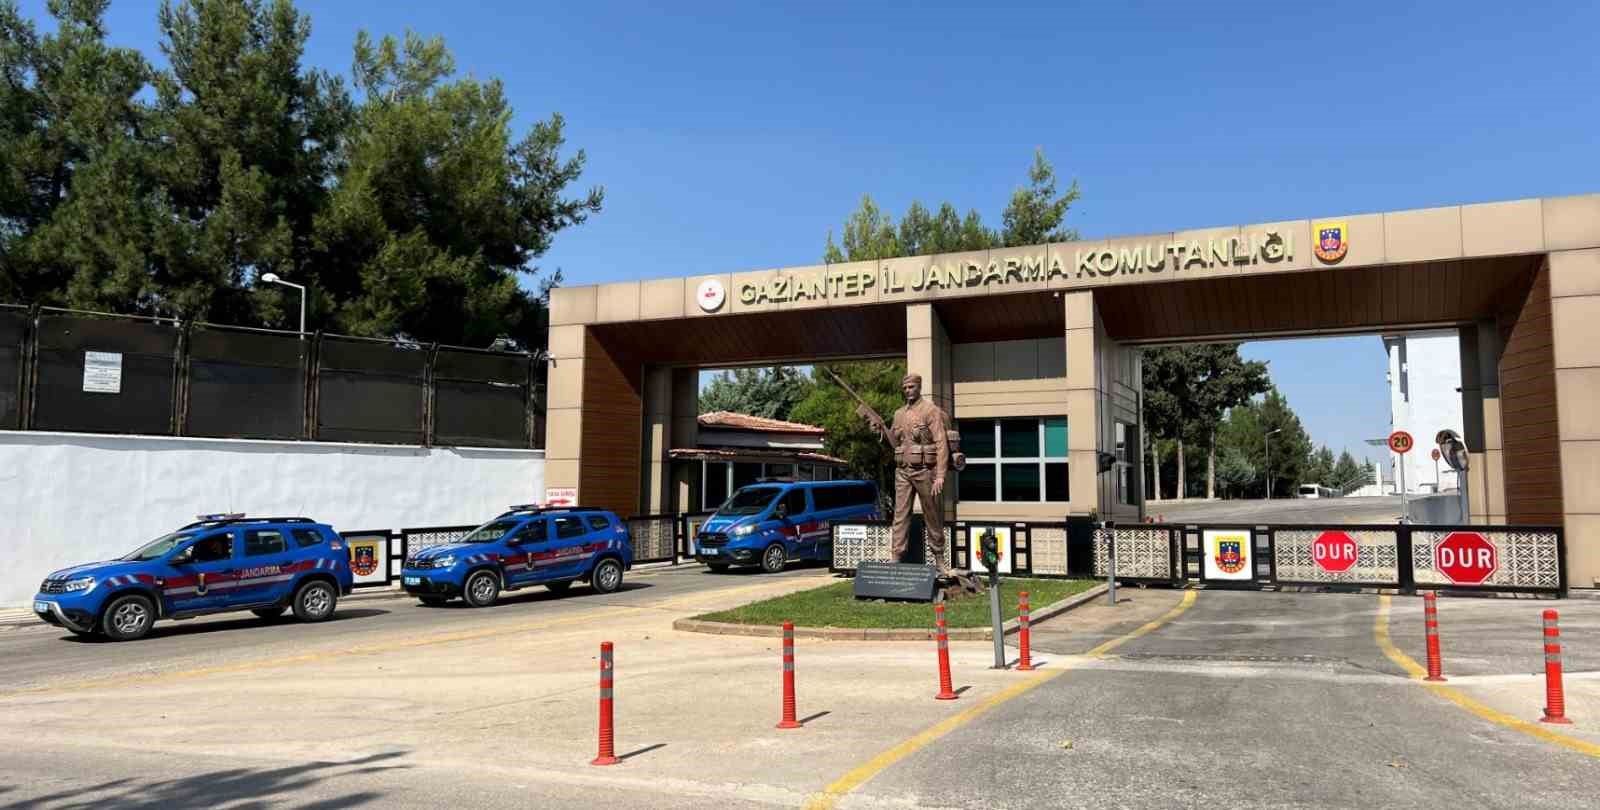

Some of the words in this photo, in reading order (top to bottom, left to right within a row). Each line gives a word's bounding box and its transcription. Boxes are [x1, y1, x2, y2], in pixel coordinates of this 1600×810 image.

[740, 270, 875, 304] GAZİANTEP
[883, 265, 905, 294] İL
[912, 251, 1068, 291] JANDARMA
[1074, 230, 1294, 279] KOMUTANLIĞI
[1392, 436, 1409, 448] 20
[1315, 543, 1355, 560] DUR
[1440, 547, 1493, 569] DUR
[240, 565, 281, 579] JANDARMA
